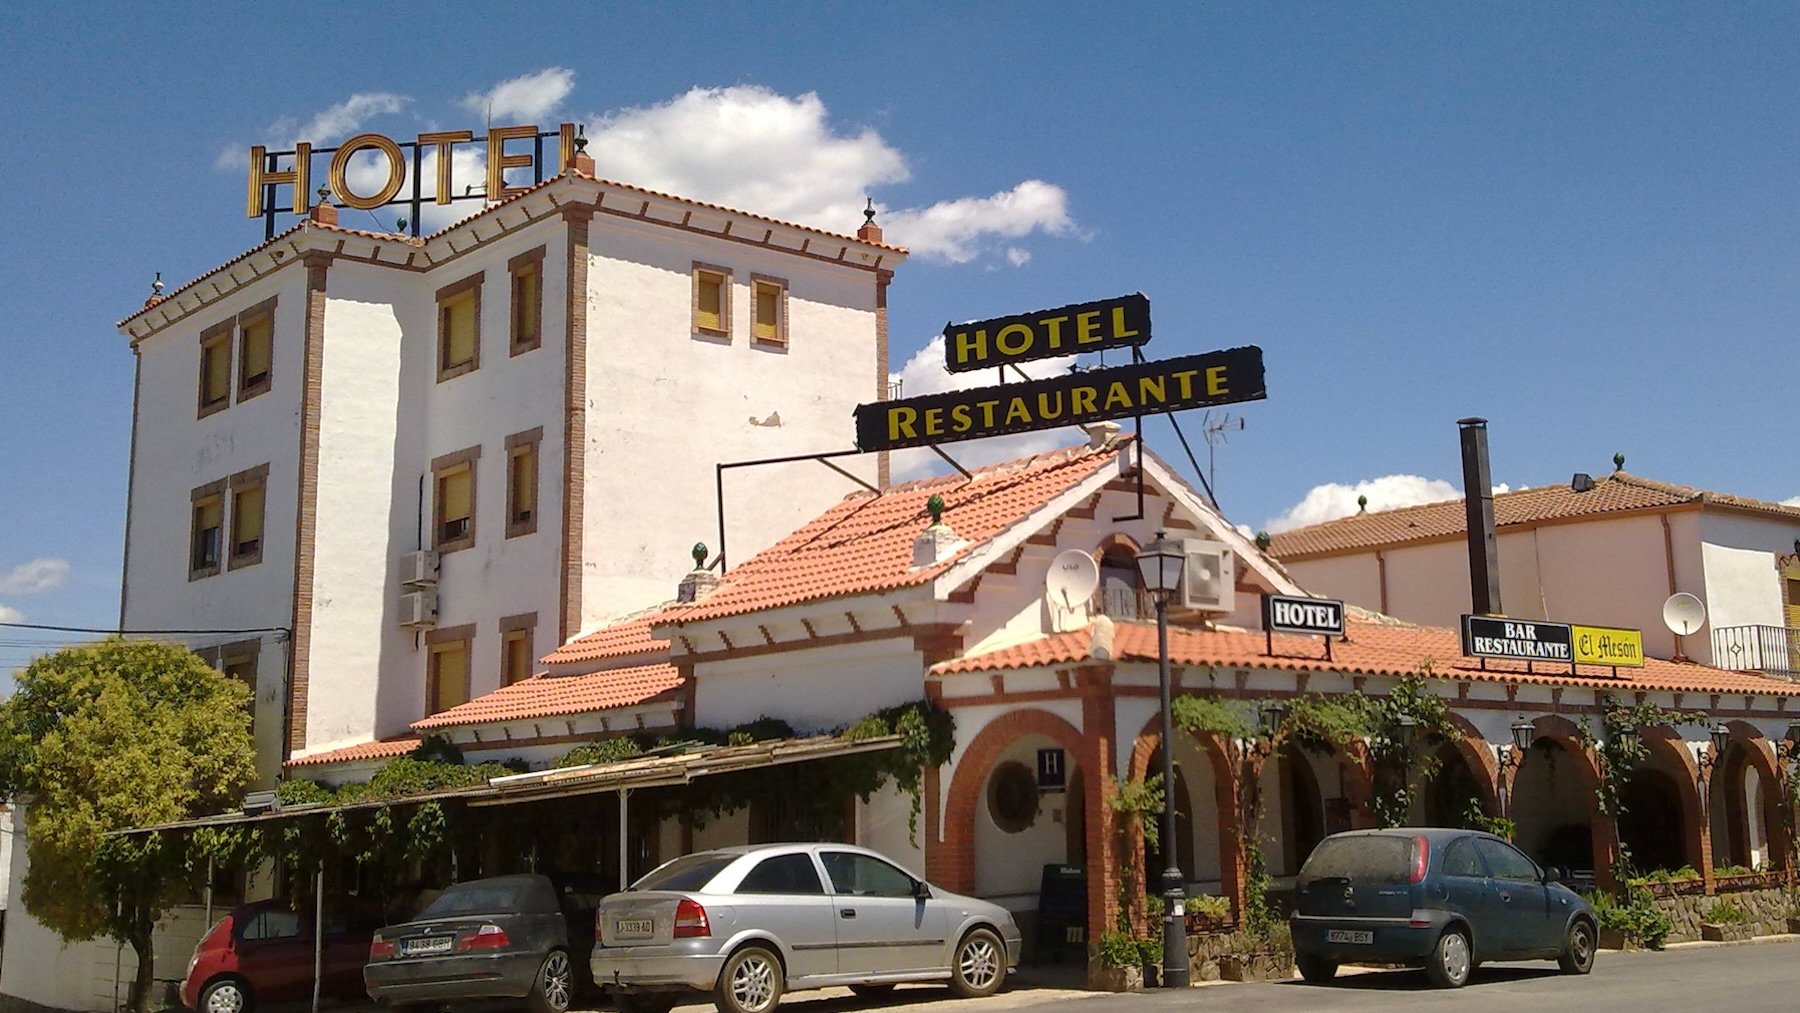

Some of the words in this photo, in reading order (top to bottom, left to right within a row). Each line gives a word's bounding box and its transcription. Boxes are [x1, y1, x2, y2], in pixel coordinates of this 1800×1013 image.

[956, 307, 1139, 364] HOTEL
[888, 366, 1230, 442] RESTAURANTE
[1274, 602, 1340, 628] HOTEL
[1504, 623, 1537, 640] BAR
[1475, 637, 1569, 659] RESTAURANTE
[1579, 634, 1594, 656] El
[1598, 635, 1637, 658] Mesón
[1045, 752, 1058, 774] H
